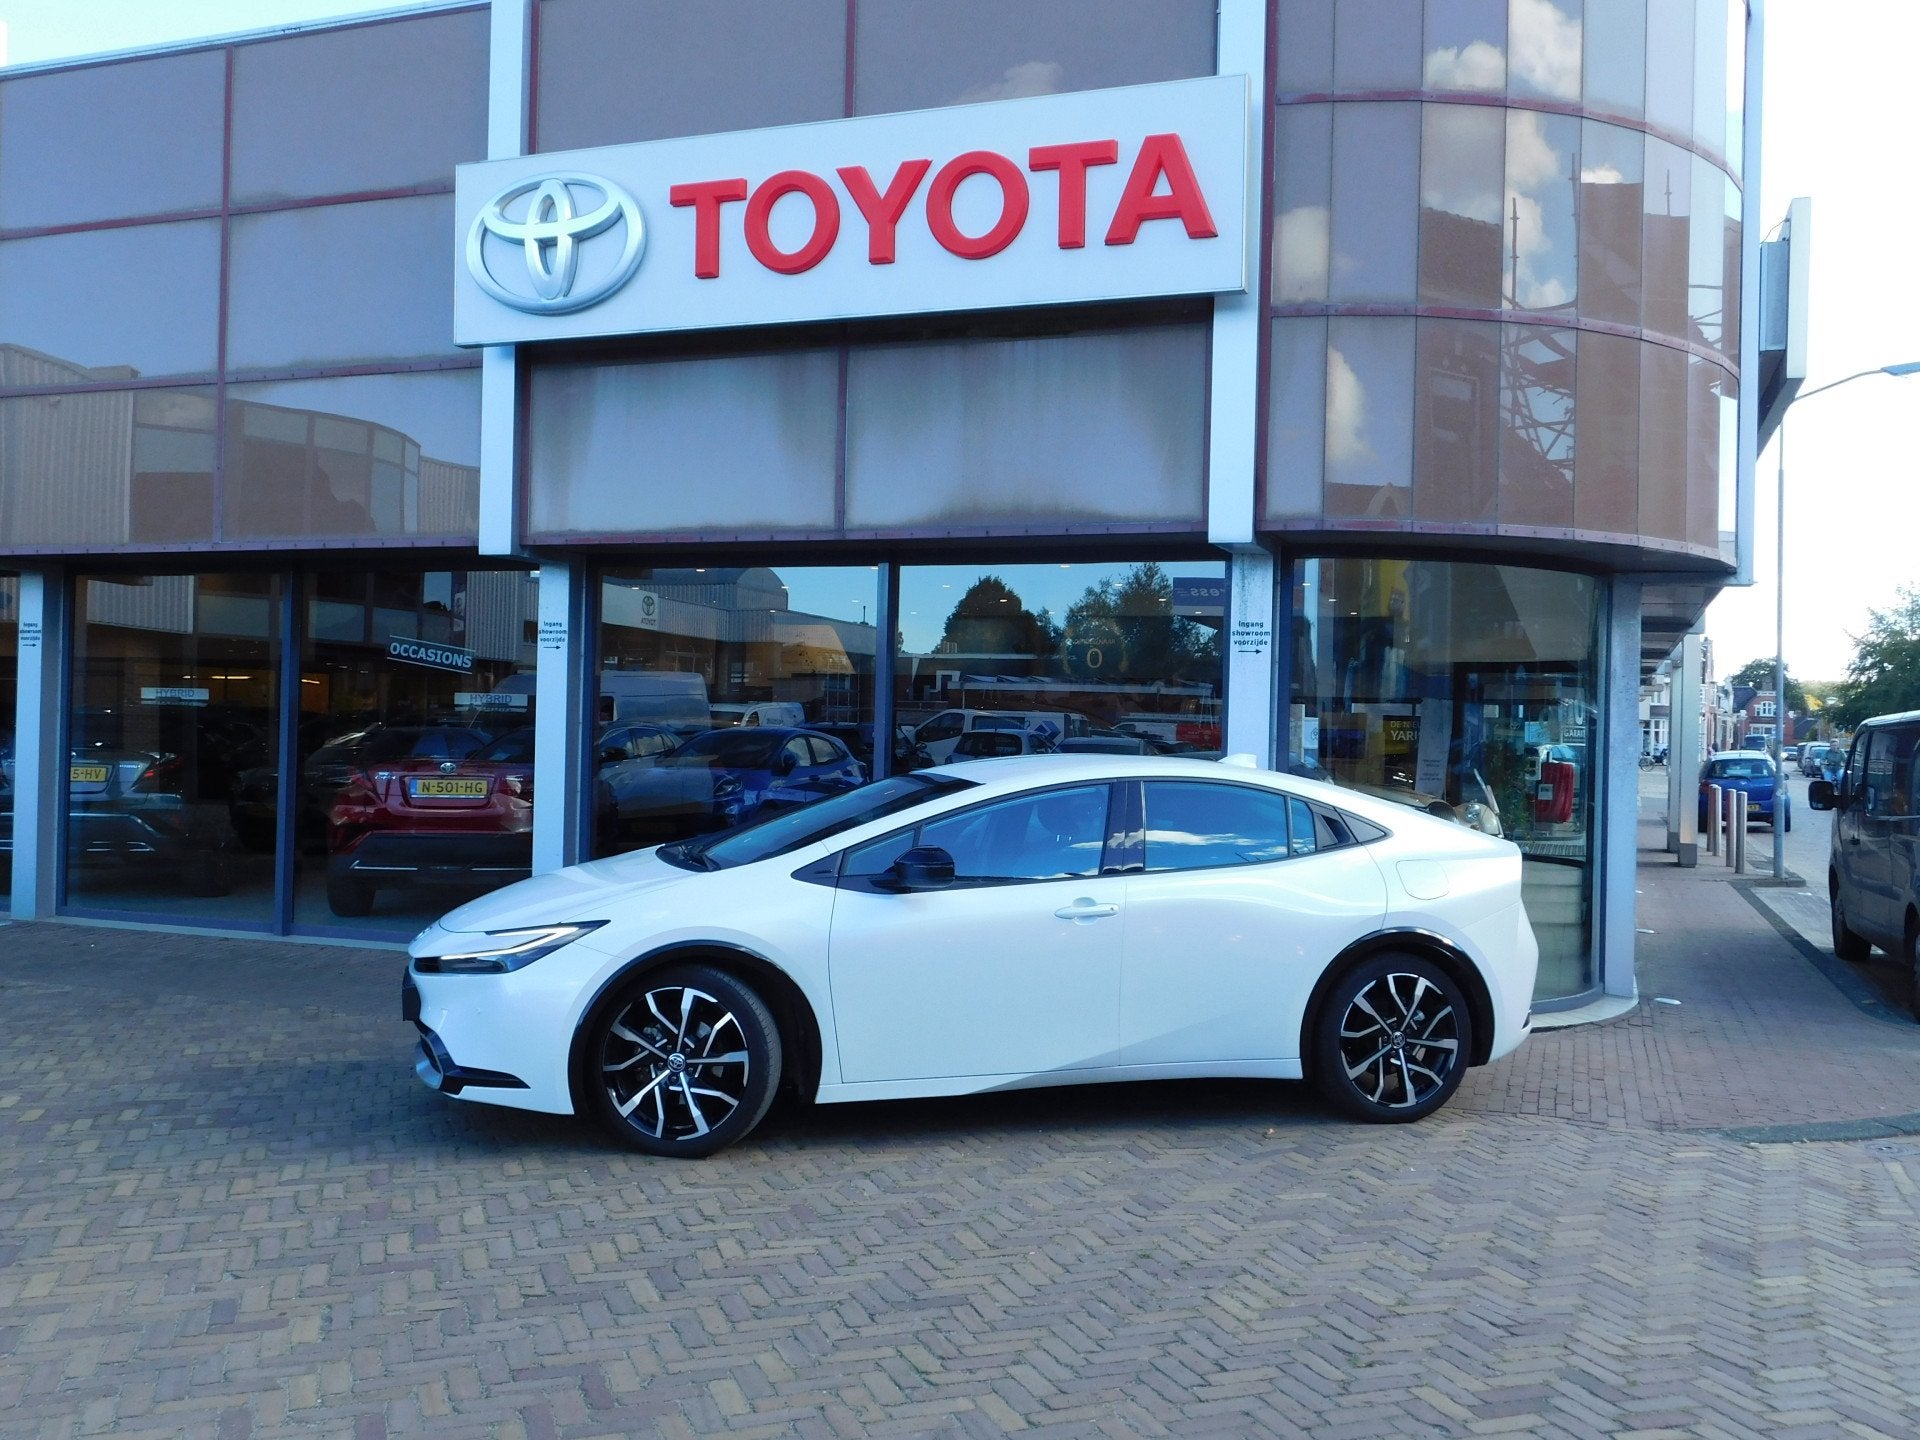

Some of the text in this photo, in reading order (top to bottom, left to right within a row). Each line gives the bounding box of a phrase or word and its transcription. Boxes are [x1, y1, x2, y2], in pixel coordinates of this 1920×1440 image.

[669, 132, 1219, 281] TOYOTA
[1238, 620, 1264, 628] Ingang
[389, 642, 473, 668] OCCASIONS
[155, 688, 195, 698] HYBRID
[470, 694, 512, 703] HYBRID
[1390, 730, 1420, 741] YARI
[421, 781, 483, 793] N-501-HG
